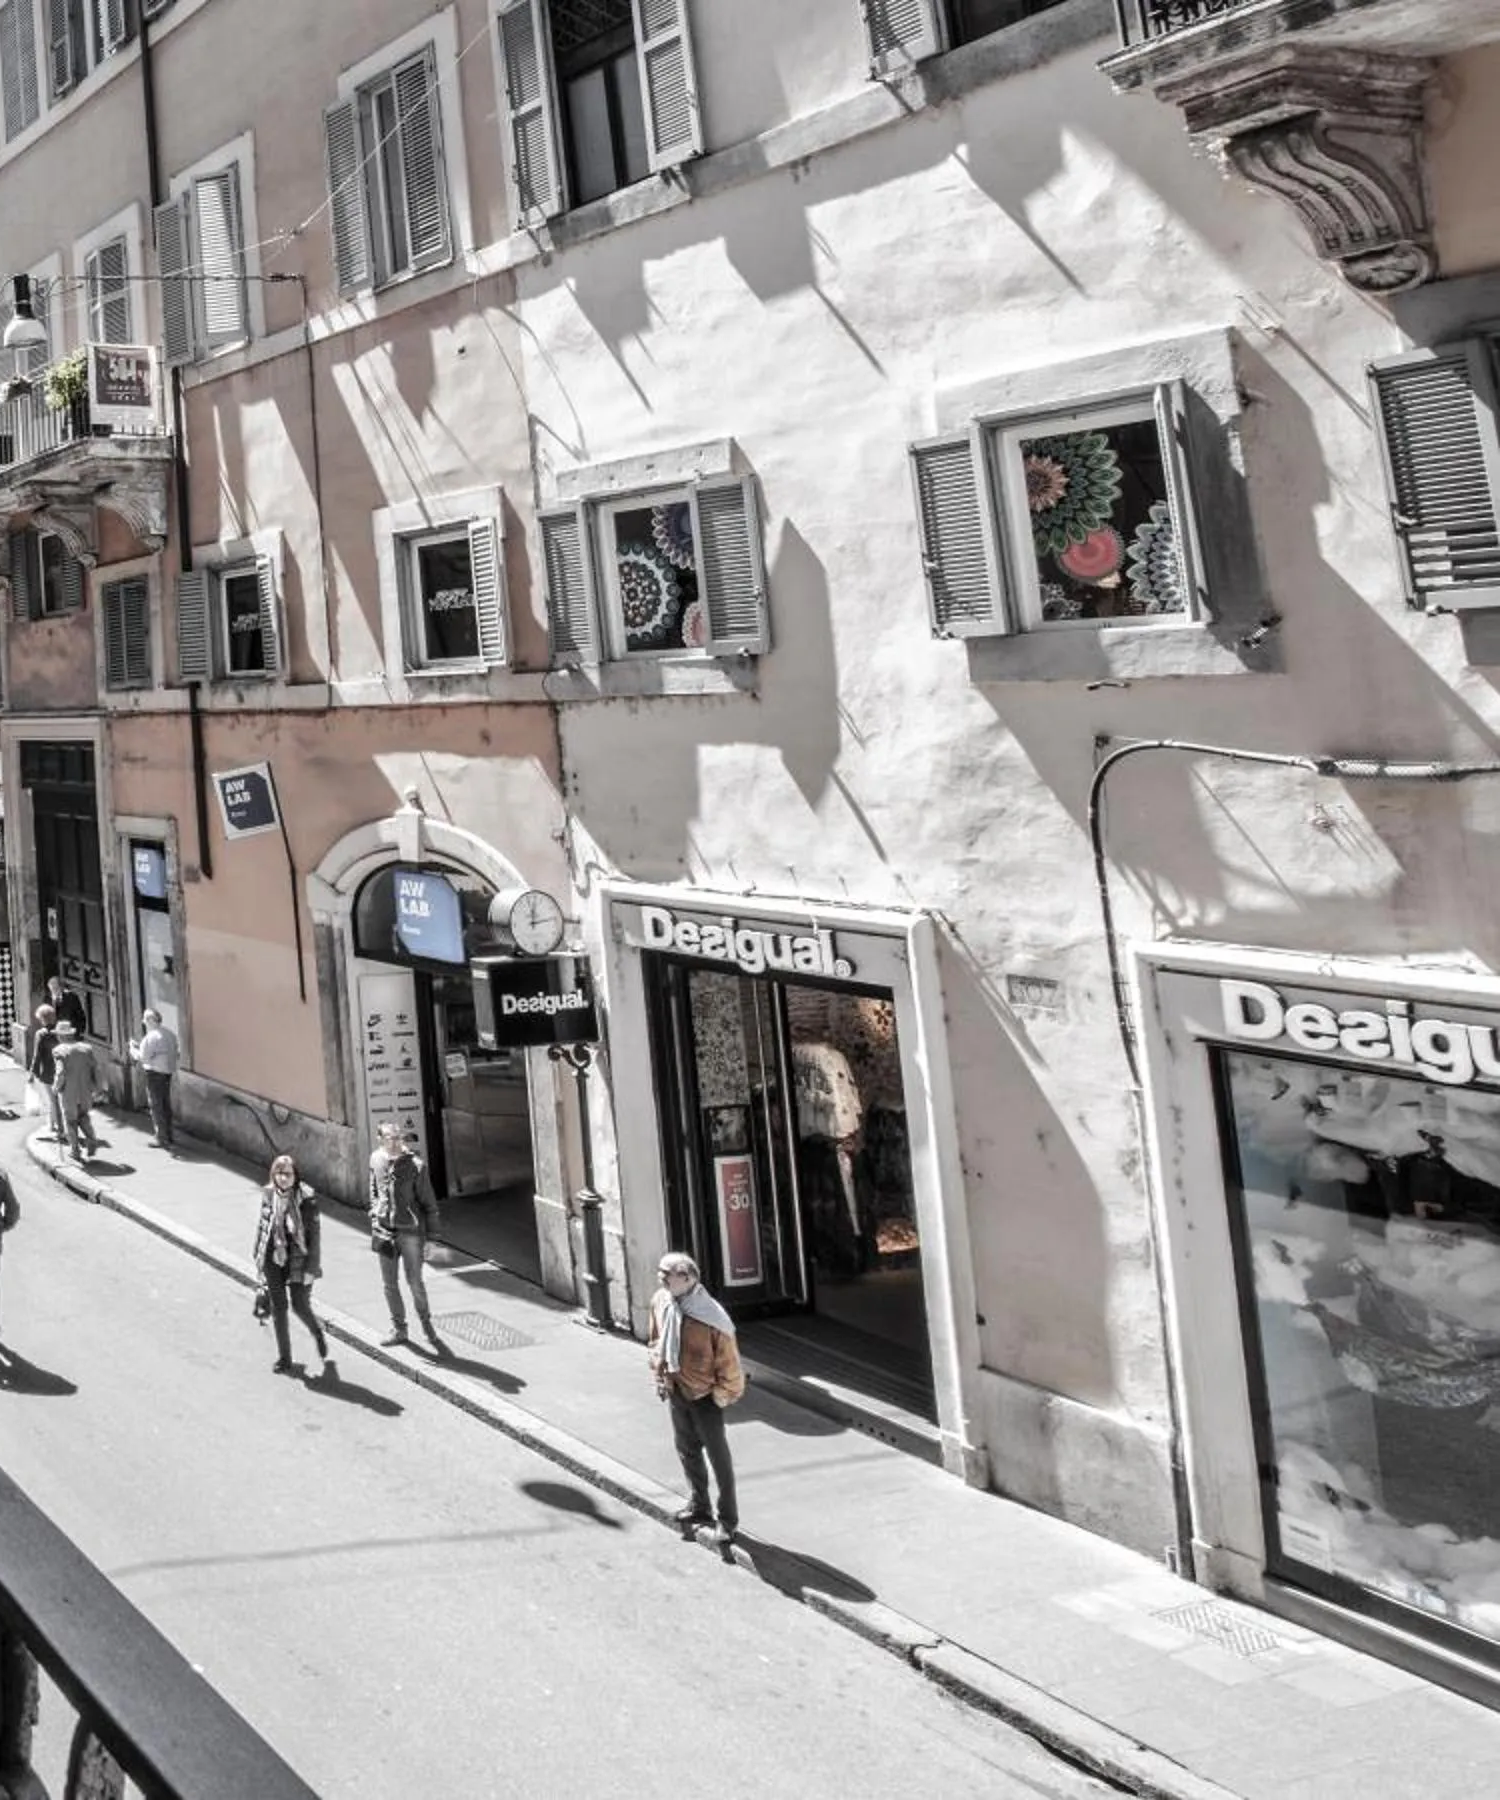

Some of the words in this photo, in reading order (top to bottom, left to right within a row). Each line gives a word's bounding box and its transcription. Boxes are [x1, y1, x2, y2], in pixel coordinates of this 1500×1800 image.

[225, 779, 245, 793] AW
[227, 791, 252, 806] LAB
[400, 879, 425, 898] AW
[401, 897, 431, 917] LAB
